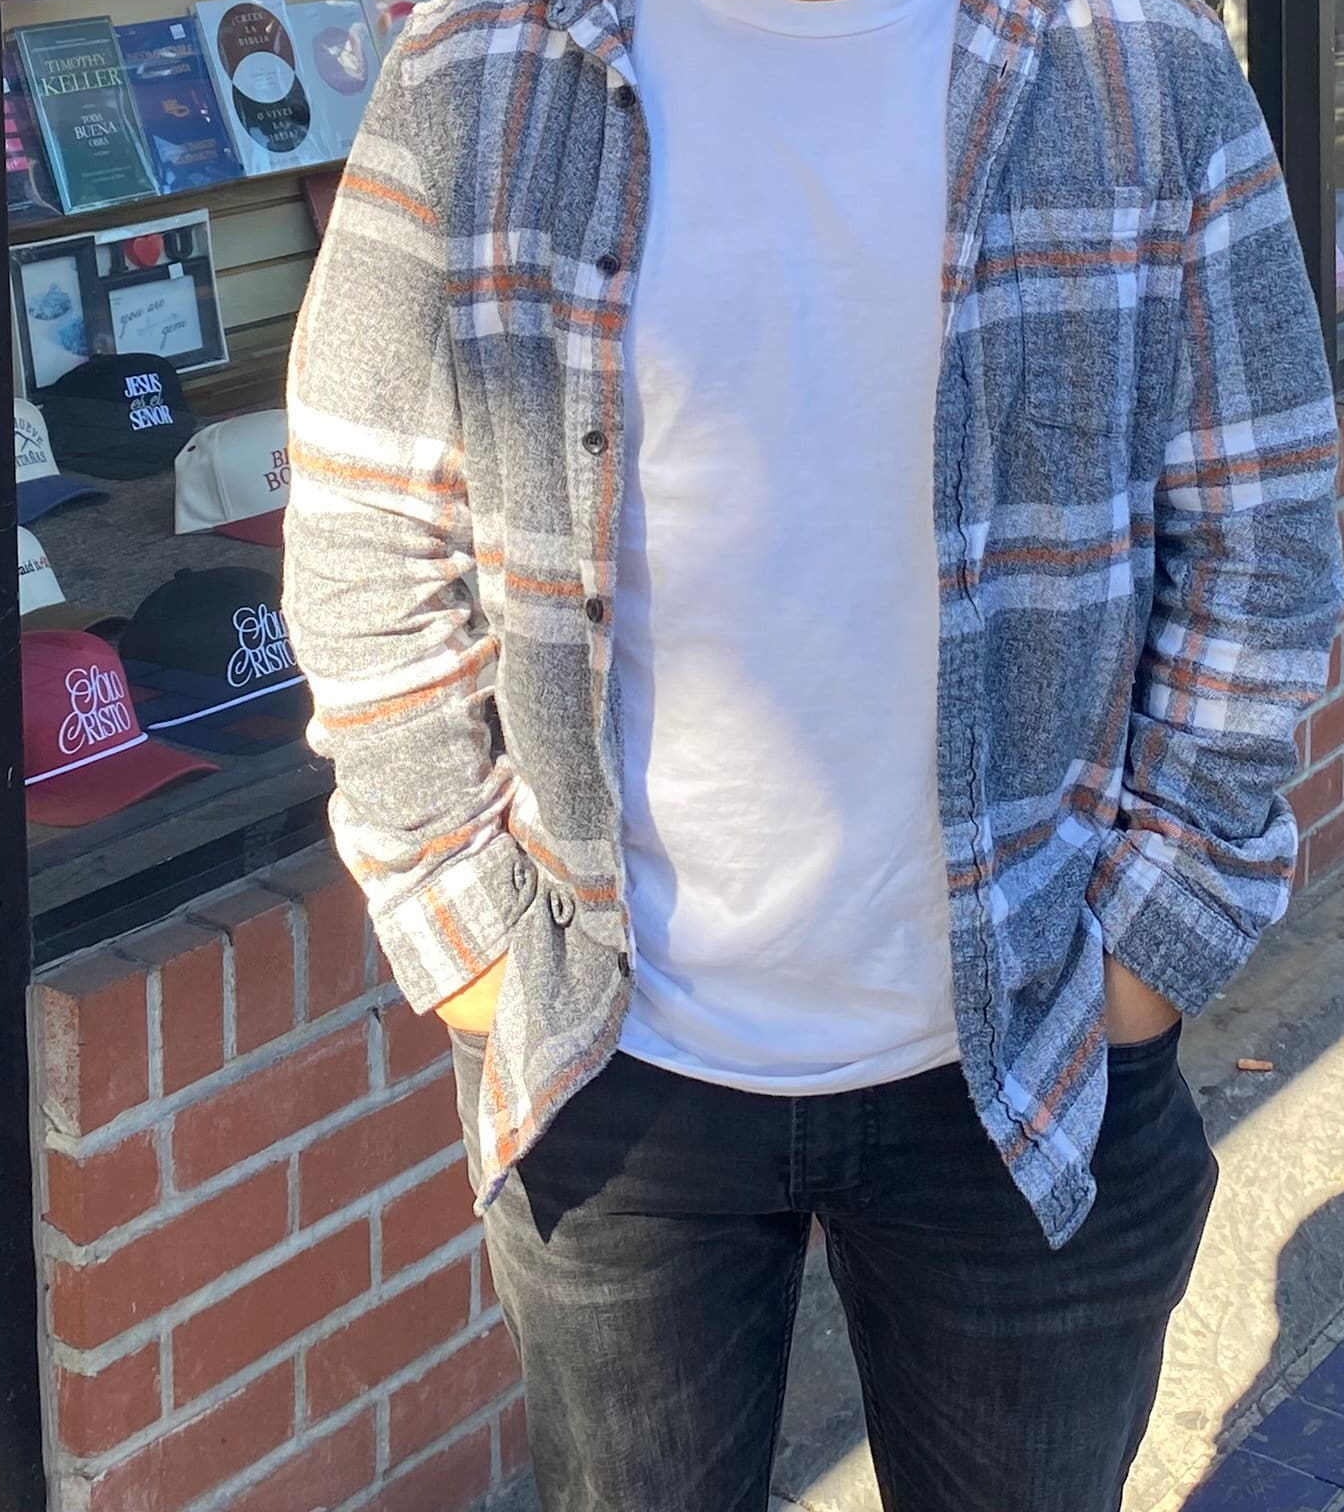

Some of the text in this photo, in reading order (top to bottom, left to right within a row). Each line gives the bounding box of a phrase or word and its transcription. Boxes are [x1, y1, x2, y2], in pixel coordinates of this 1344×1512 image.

[45, 53, 105, 73] TIMOTHY
[40, 66, 123, 96] KELLER
[74, 121, 117, 139] BUENA
[163, 229, 193, 260] U
[124, 373, 162, 398] JESUS
[233, 604, 289, 651] SOL
[59, 702, 131, 755] CRISTO
